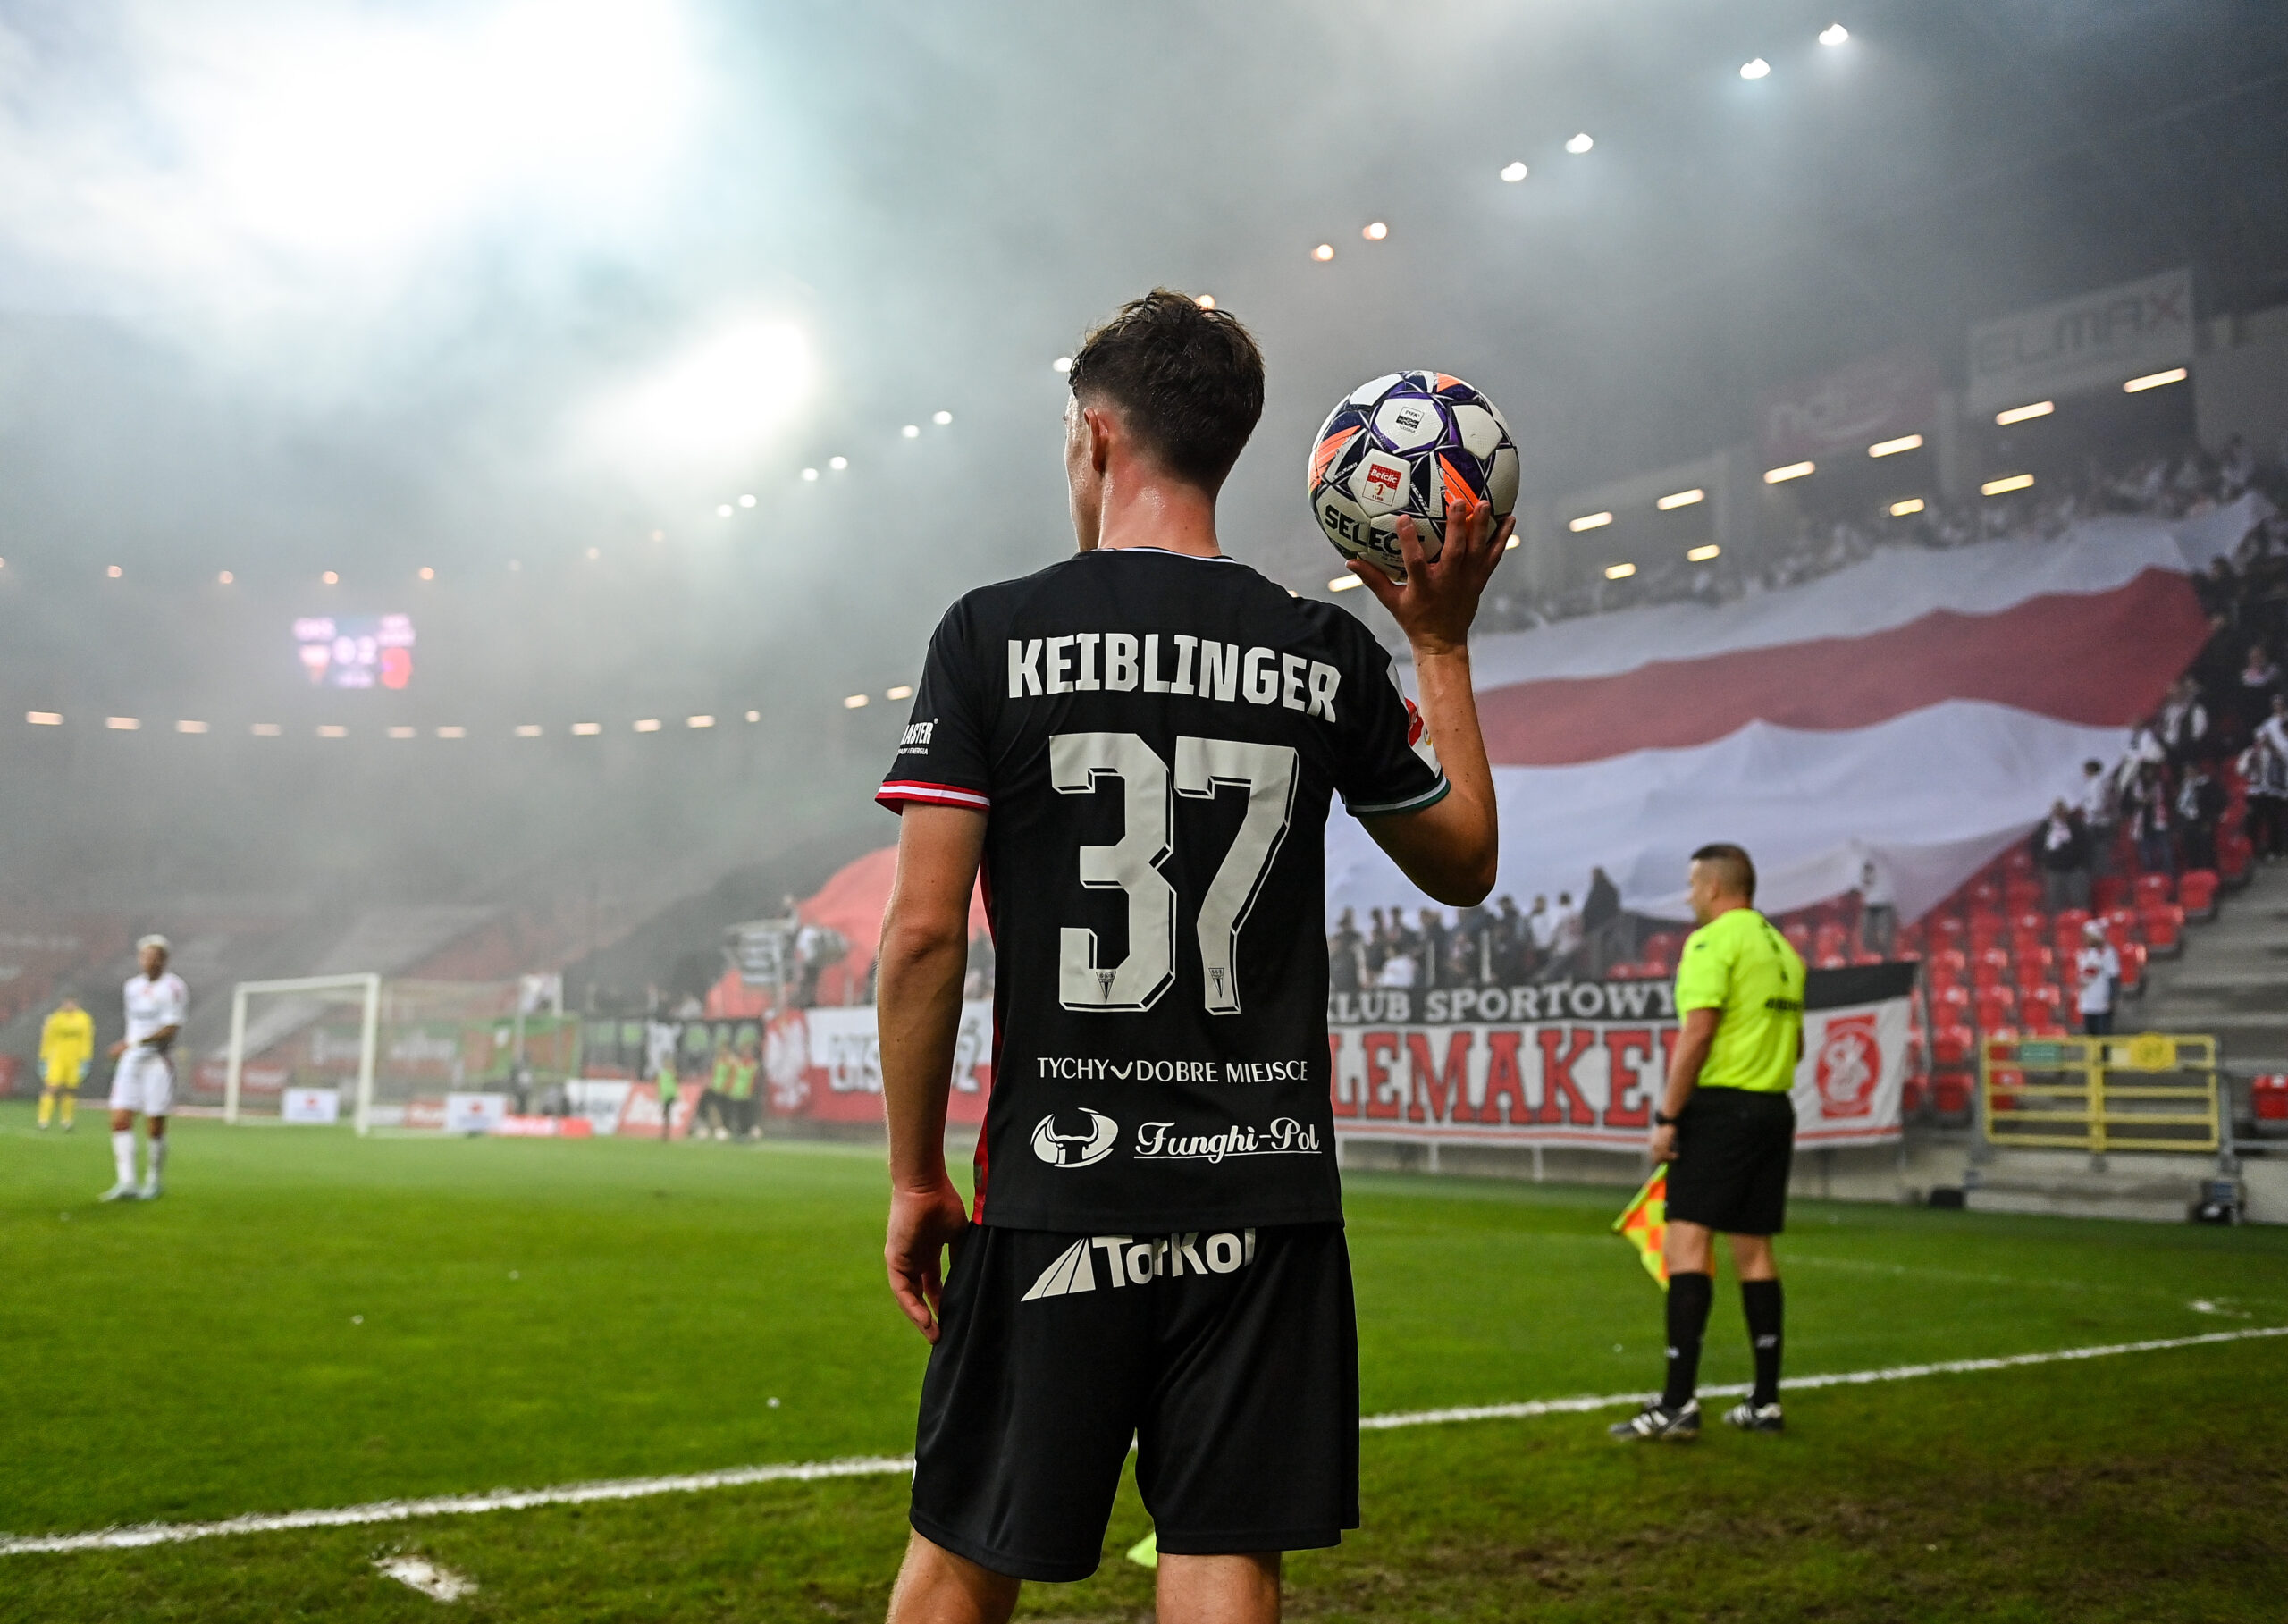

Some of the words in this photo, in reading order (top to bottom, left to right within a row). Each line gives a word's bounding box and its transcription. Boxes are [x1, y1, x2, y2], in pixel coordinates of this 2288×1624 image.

[1370, 469, 1398, 484] Betclic
[1325, 504, 1425, 555] SELEC
[1007, 632, 1342, 723] KEIBLINGER
[1048, 732, 1300, 1016] 37
[1329, 991, 1410, 1023] LUB
[1037, 1057, 1110, 1081] TYCHY
[1136, 1060, 1219, 1082] DOBRE
[1225, 1060, 1308, 1083] MIEJSCE
[1329, 1028, 1678, 1127] LEMAKE
[1134, 1117, 1322, 1164] Funghi-Pol
